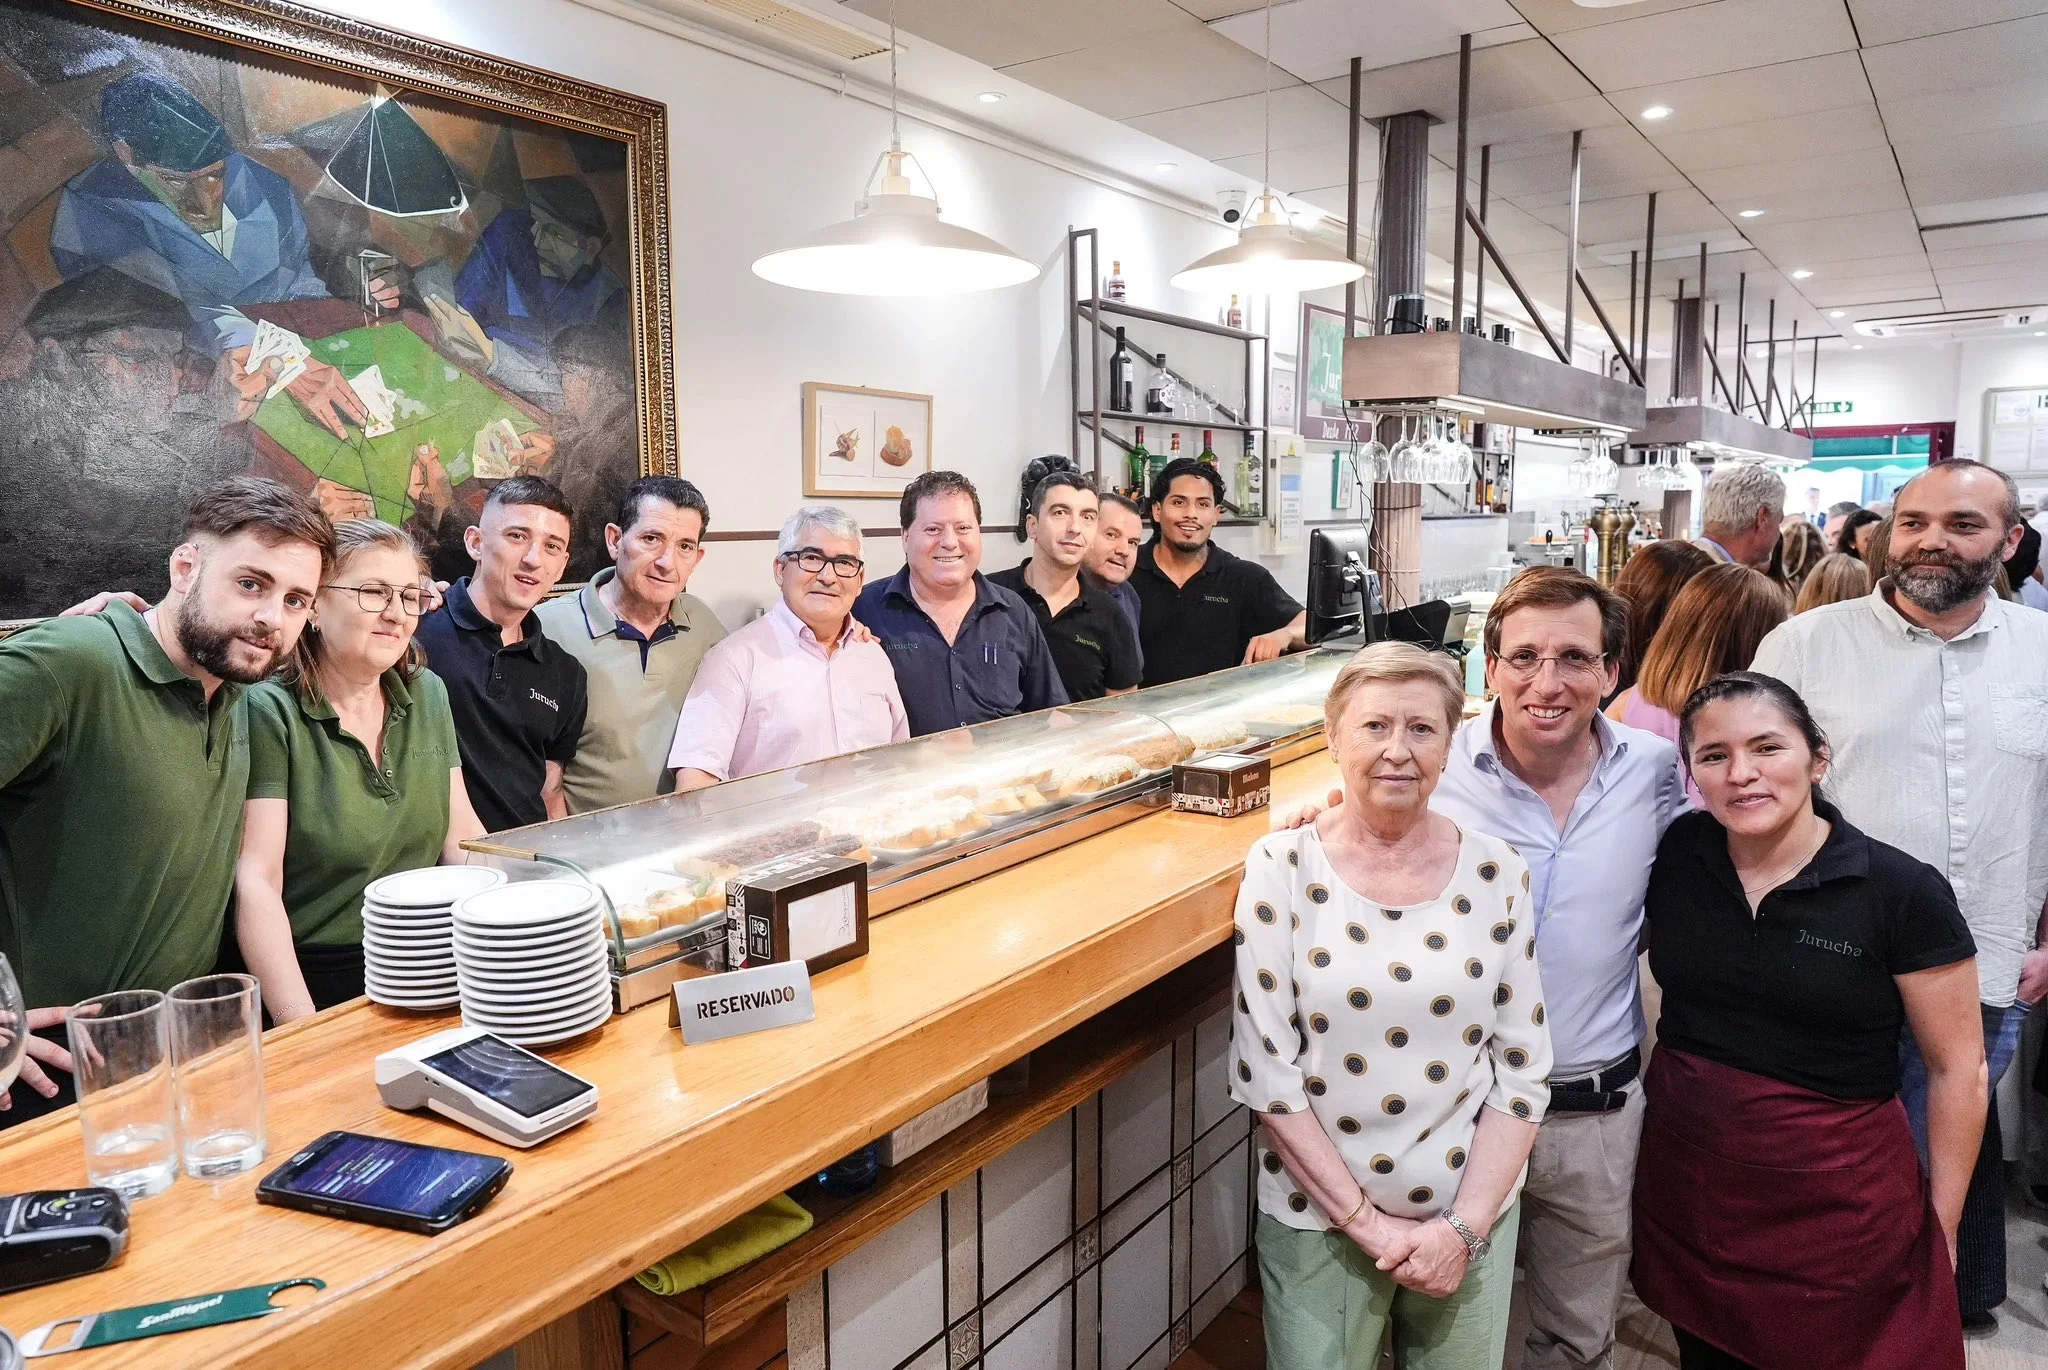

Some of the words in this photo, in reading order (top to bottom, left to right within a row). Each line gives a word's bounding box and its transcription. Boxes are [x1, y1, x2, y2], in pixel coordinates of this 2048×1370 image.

[529, 687, 559, 712] Juruch
[1795, 929, 1863, 957] Jurucha
[696, 985, 796, 1020] RESERVADO
